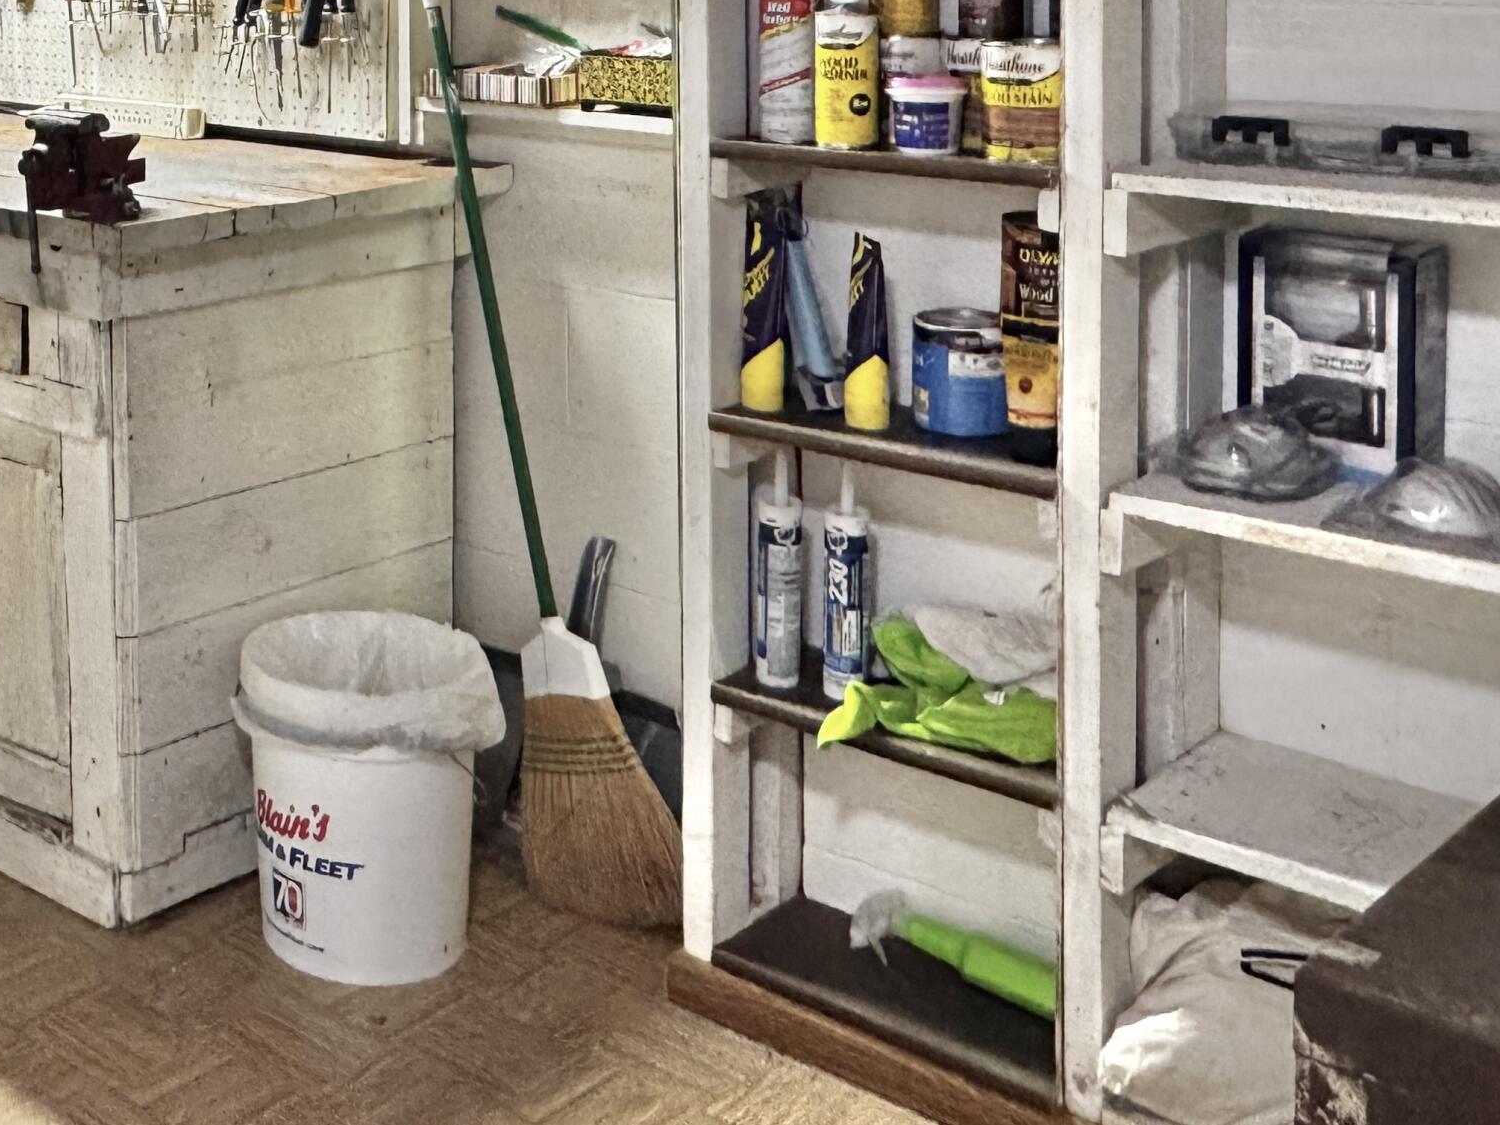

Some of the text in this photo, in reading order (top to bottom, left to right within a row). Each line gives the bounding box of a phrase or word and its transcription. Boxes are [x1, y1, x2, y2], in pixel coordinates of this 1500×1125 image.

[828, 557, 849, 606] 230
[257, 788, 330, 842] Blain's
[289, 846, 364, 880] FLEET
[273, 874, 303, 919] 70
